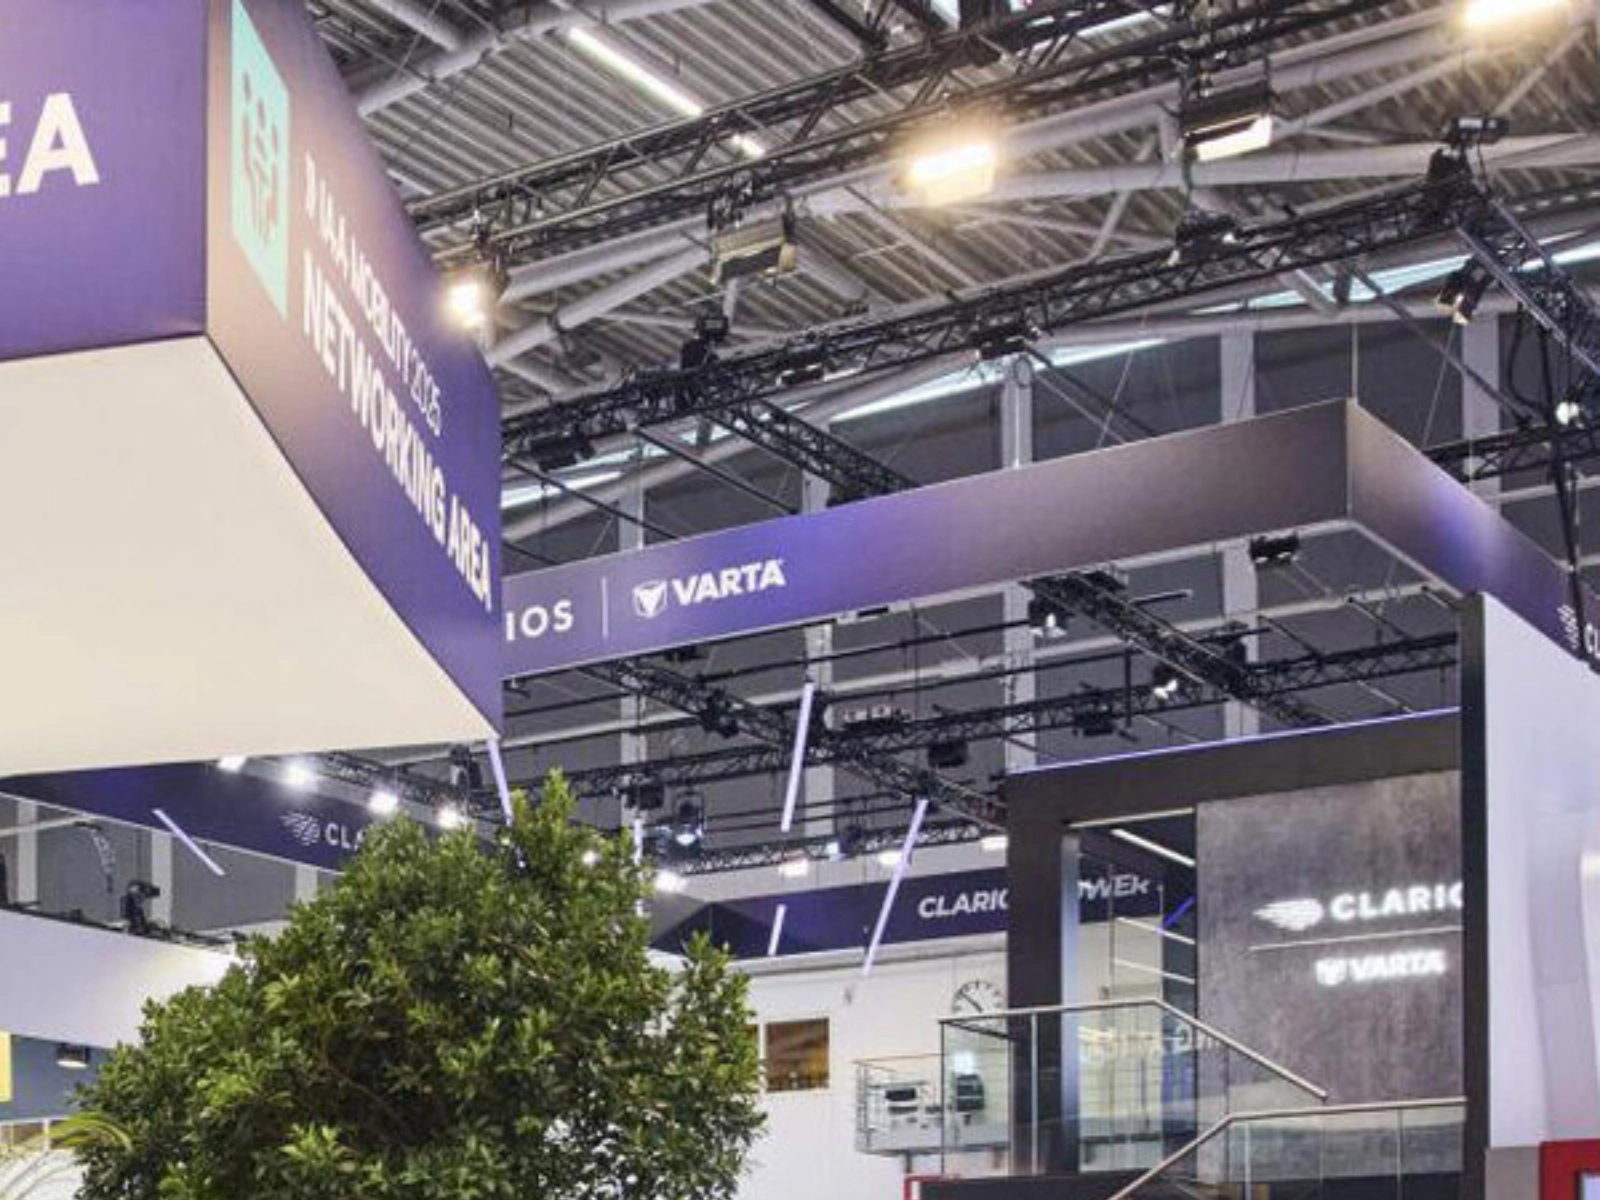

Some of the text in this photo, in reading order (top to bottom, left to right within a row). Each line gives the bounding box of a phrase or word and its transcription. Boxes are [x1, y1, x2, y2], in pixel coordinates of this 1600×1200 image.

[350, 234, 412, 385] MOBILITY
[409, 346, 442, 438] 2025
[303, 247, 493, 614] NETWORKING AREA
[672, 558, 786, 607] VARTA
[505, 599, 574, 642] IOS
[1350, 949, 1448, 983] VARTA
